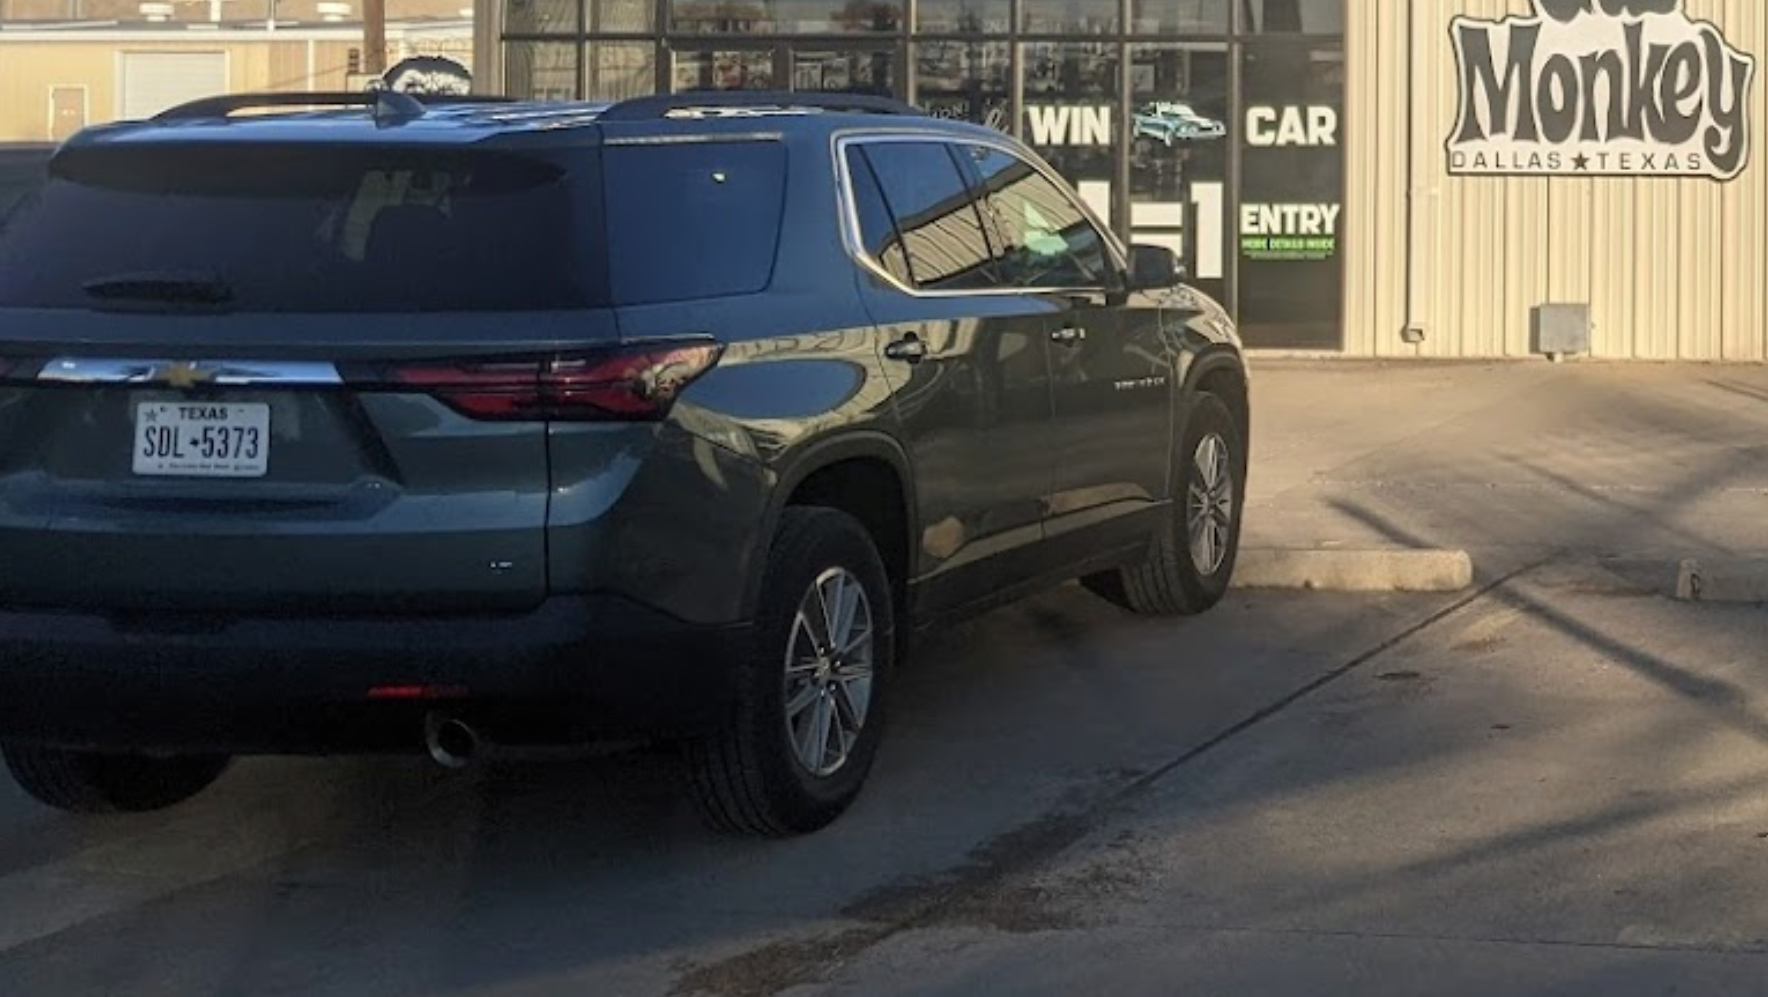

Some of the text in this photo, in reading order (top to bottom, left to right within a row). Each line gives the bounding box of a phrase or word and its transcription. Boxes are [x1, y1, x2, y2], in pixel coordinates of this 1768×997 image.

[1454, 22, 1751, 174] Monkey
[1028, 105, 1111, 146] WIN
[1245, 106, 1337, 147] CAR
[1450, 150, 1703, 171] DALLAS TEXAS
[1239, 203, 1340, 235] ENTRY
[178, 406, 228, 420] TEXAS
